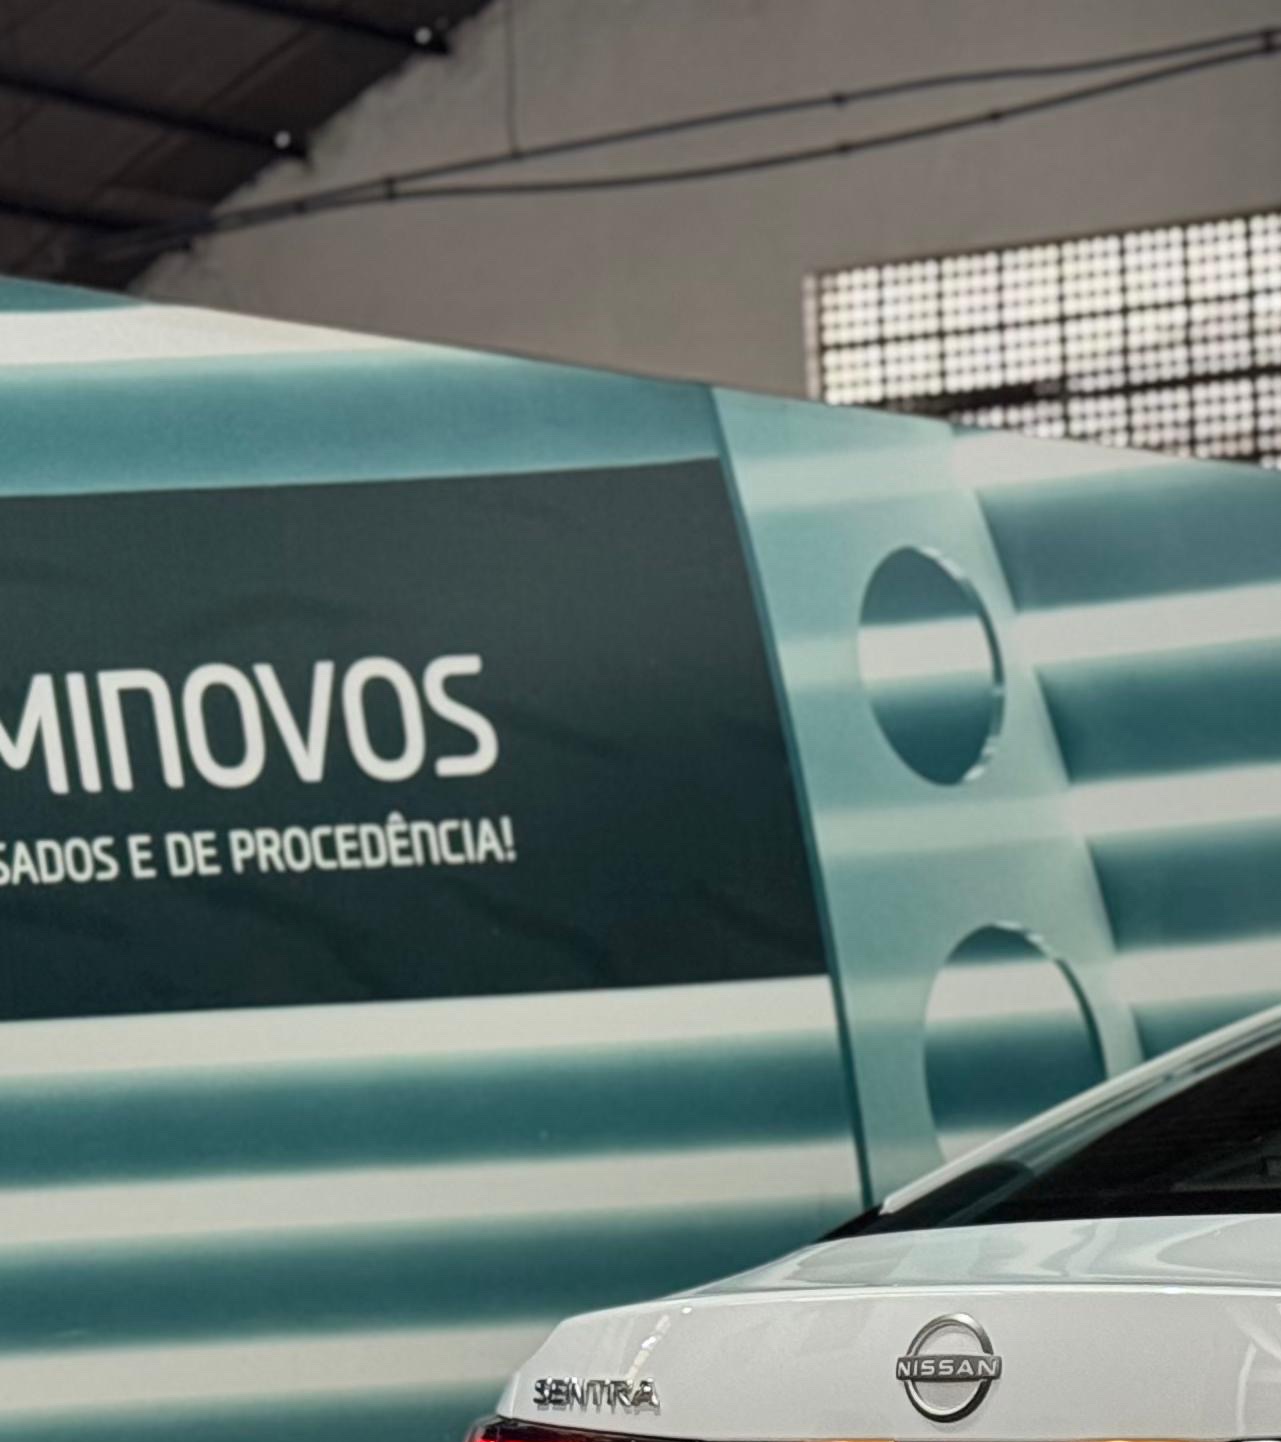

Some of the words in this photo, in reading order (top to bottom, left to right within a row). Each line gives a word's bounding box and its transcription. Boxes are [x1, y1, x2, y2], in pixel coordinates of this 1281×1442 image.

[127, 833, 157, 880] E
[165, 830, 222, 878] DE
[229, 812, 517, 875] PROCEDÊNCIA!
[898, 1355, 998, 1377] NISSAN
[532, 1375, 661, 1410] SENTRA
